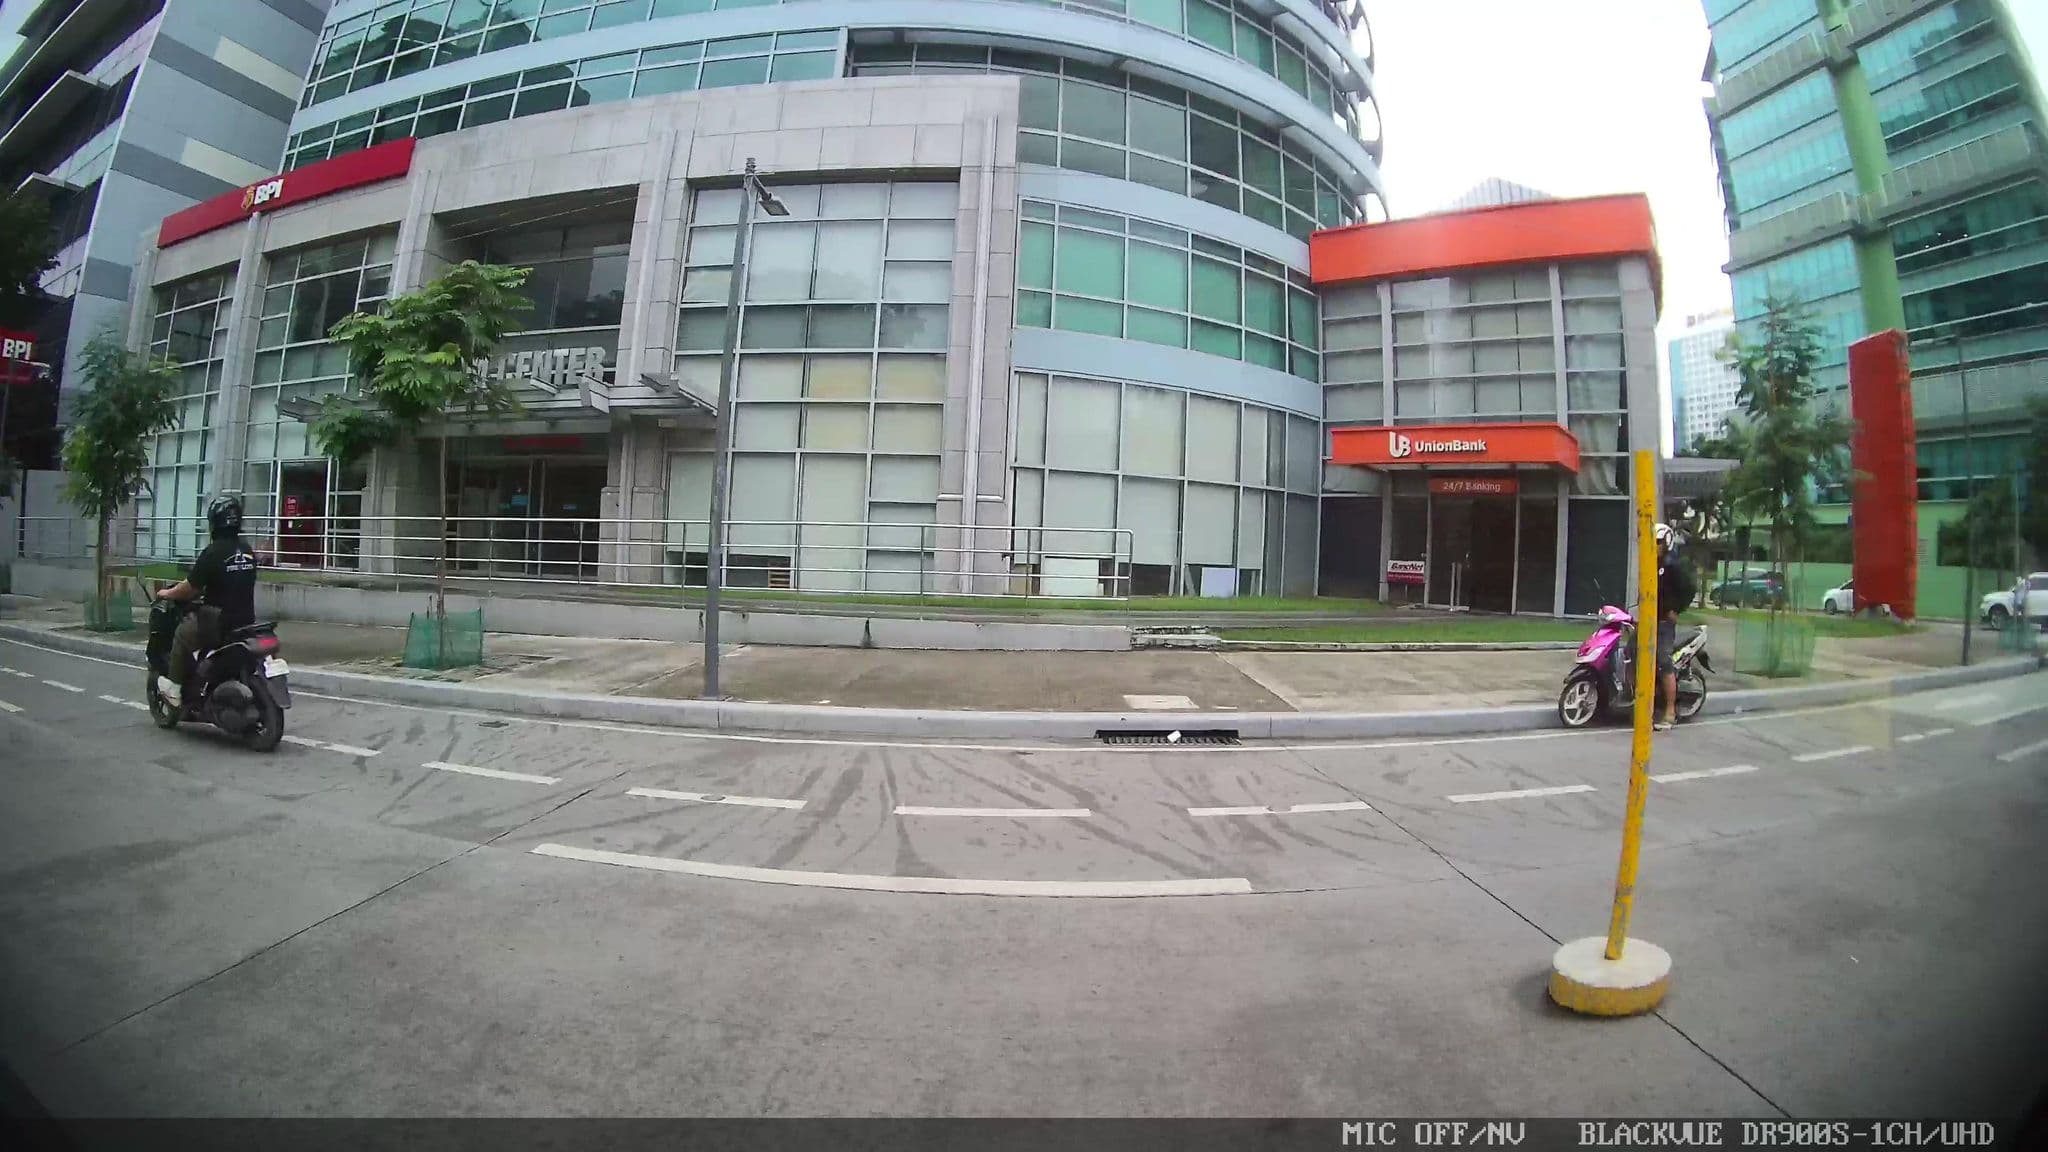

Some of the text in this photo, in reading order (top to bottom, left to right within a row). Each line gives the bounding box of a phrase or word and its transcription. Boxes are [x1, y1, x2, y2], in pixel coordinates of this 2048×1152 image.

[254, 179, 284, 204] BPI
[2, 338, 32, 360] BPI
[1415, 439, 1487, 452] UnionBank
[1443, 481, 1501, 492] 24/7 Banking
